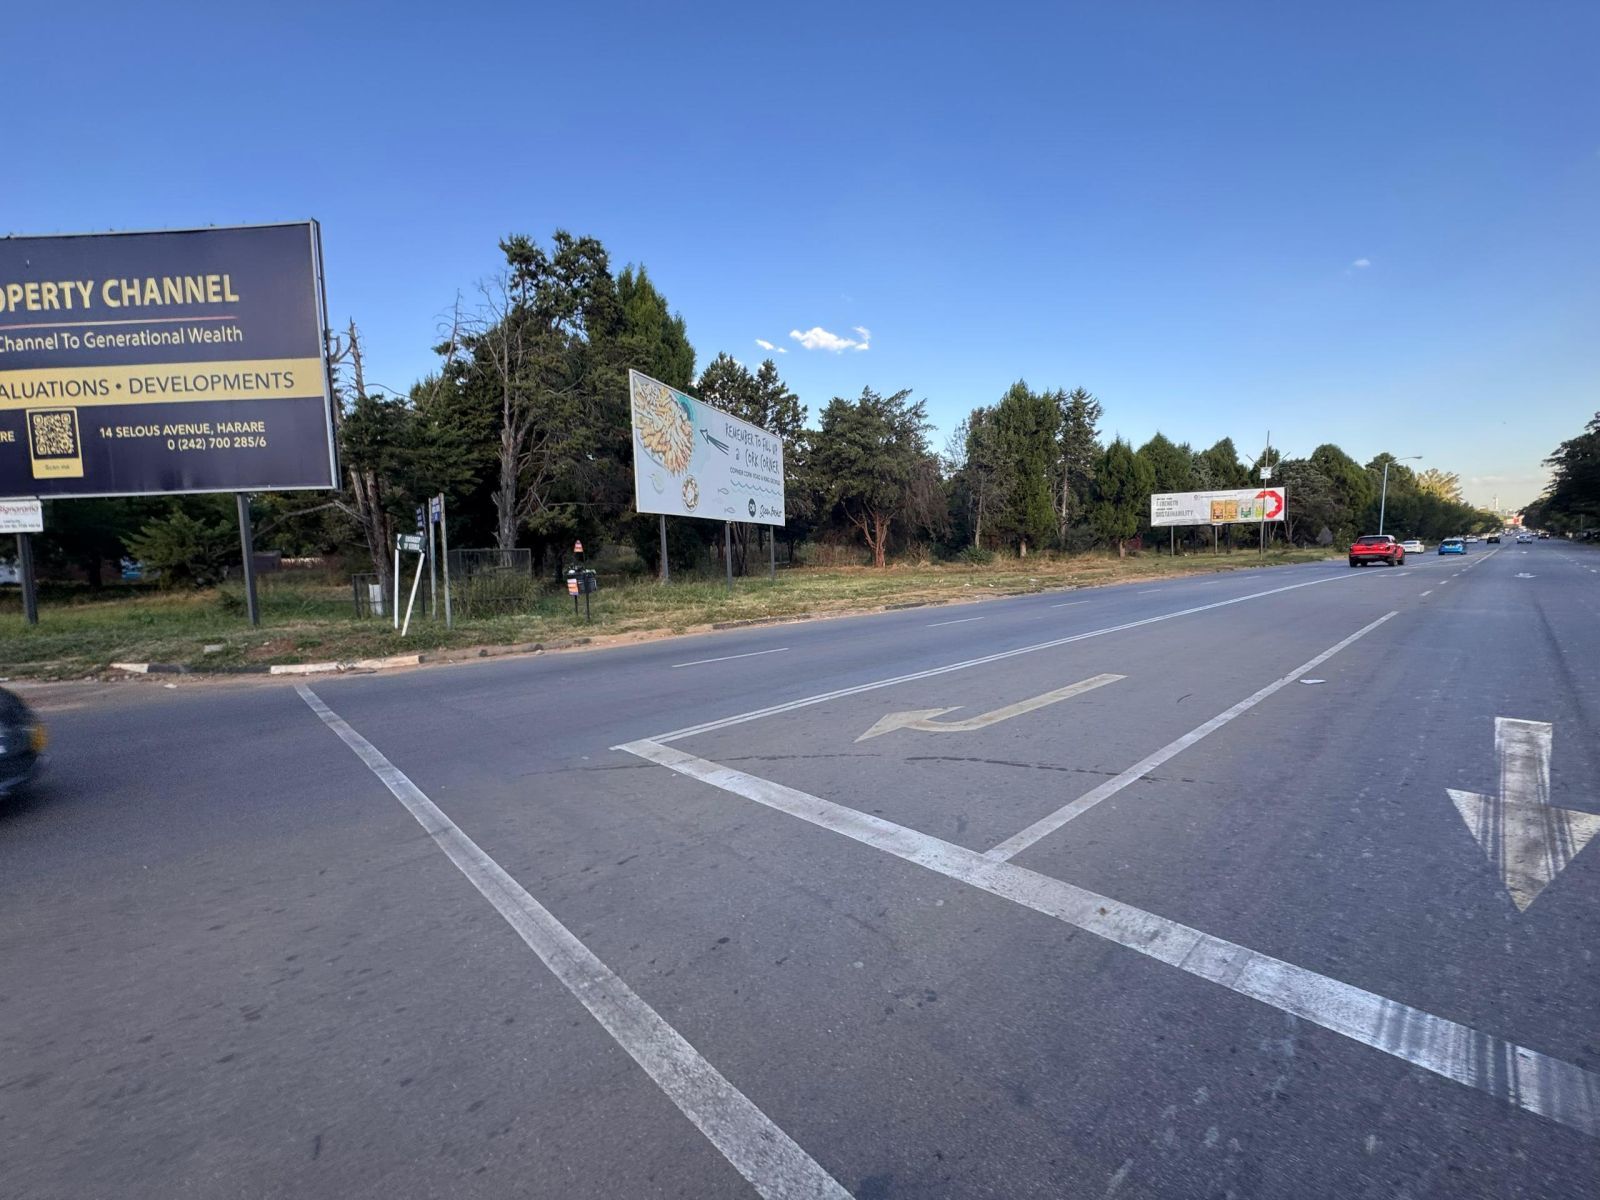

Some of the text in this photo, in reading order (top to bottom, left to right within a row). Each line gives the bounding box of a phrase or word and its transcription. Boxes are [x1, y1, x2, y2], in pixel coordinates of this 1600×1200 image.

[0, 274, 240, 313] PERTY CHANNEL
[61, 332, 80, 349] To
[84, 327, 185, 349] Generational
[188, 325, 243, 345] Wealth
[129, 371, 295, 396] DEVELOPMENTS
[99, 420, 265, 439] 14 SELOUS AVENUE, HARARE
[725, 423, 754, 446] REMEMBER
[762, 437, 772, 453] FILL
[178, 437, 206, 452] (242)
[208, 437, 231, 449] 700
[233, 436, 267, 449] 285/6
[745, 448, 759, 468] CORK
[760, 453, 780, 475] CORNER
